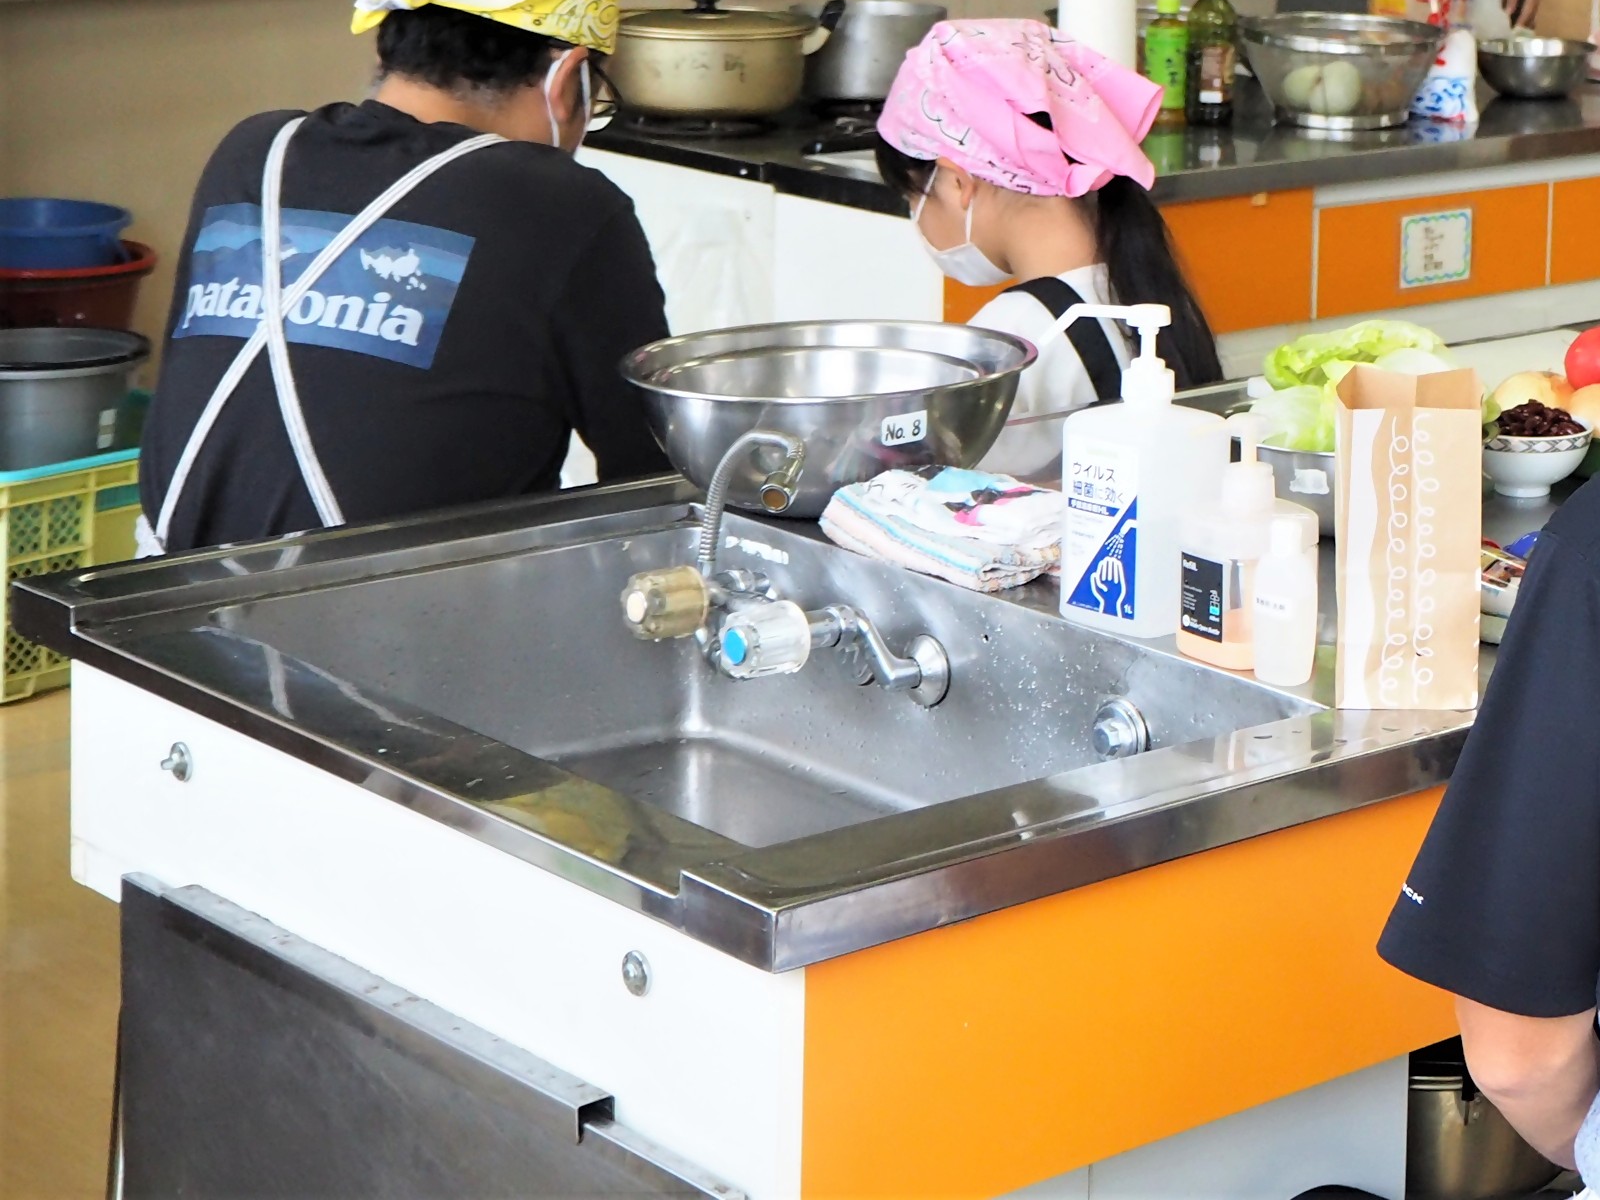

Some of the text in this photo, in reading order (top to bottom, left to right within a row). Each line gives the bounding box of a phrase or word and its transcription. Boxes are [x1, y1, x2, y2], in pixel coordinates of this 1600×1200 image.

[182, 277, 424, 347] pataonia
[885, 419, 921, 441] No. 8
[1072, 462, 1116, 482] ウイルス
[1073, 480, 1125, 504] 細菌に効く
